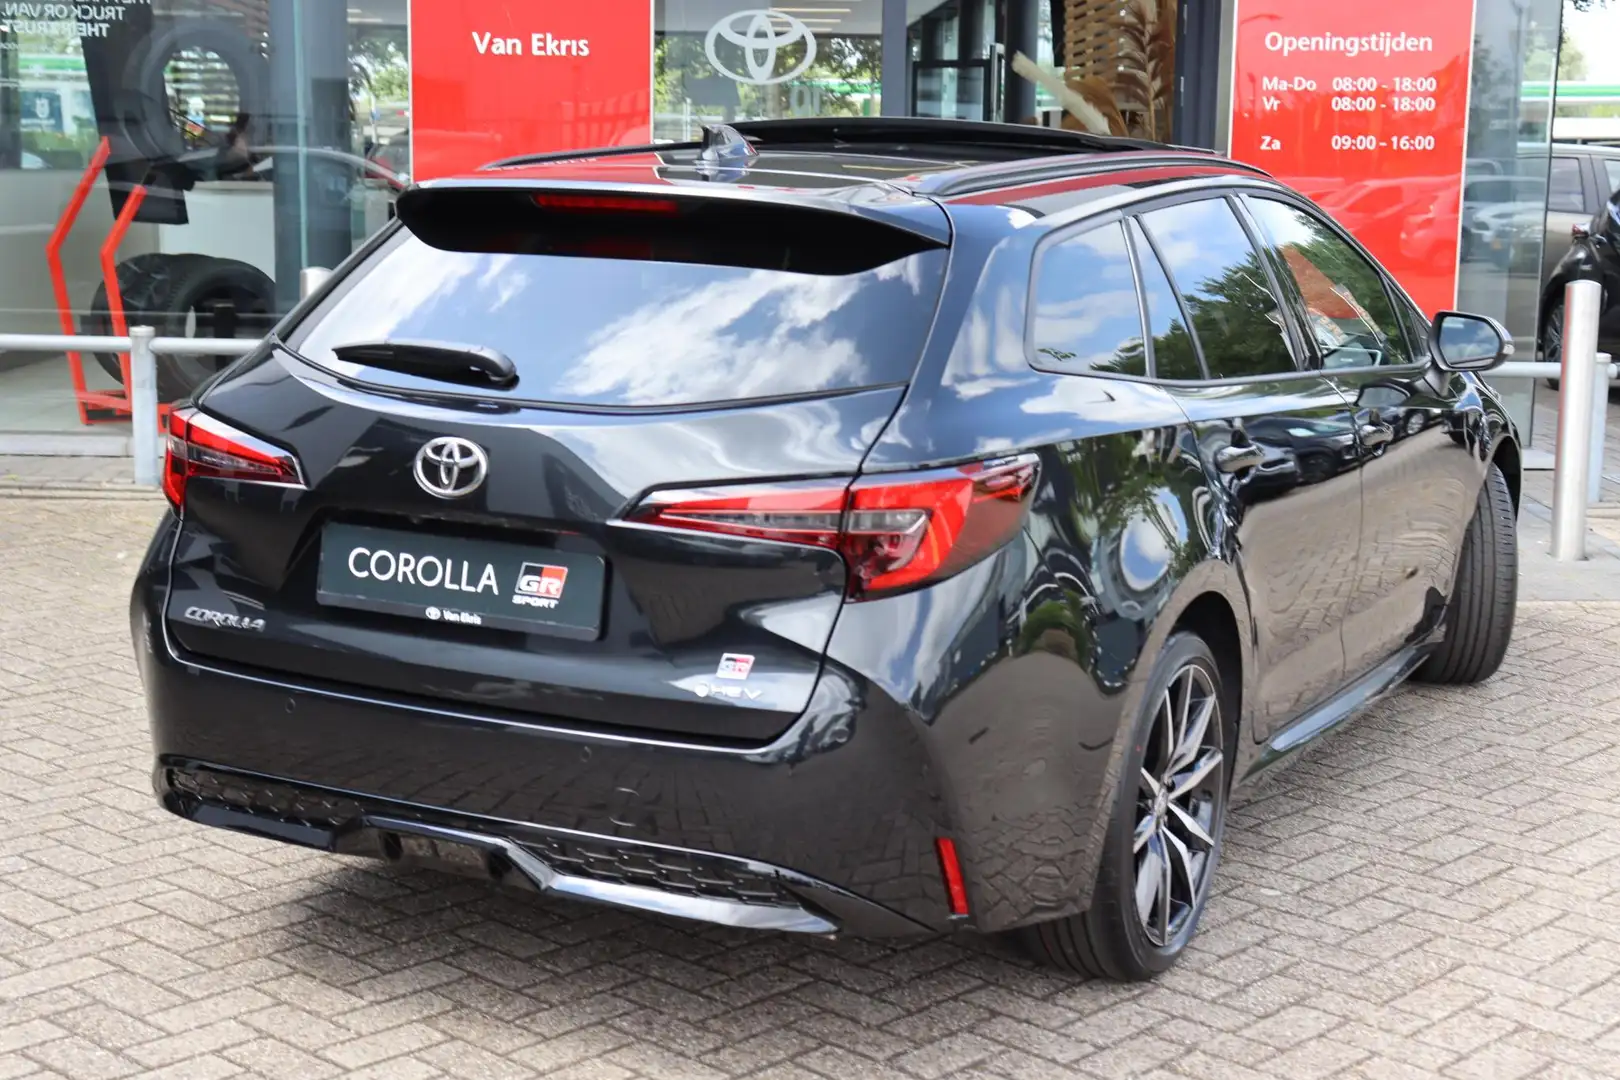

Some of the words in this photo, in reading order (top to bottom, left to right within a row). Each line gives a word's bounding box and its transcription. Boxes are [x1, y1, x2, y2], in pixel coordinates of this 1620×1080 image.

[472, 31, 522, 55] Van
[531, 32, 590, 56] Ekris
[1264, 31, 1433, 57] Openingstijden
[1262, 76, 1317, 91] Ma-Do
[1332, 77, 1377, 92] 08:00
[1393, 77, 1437, 92] 18:00
[1262, 96, 1280, 111] Vr
[1331, 97, 1376, 112] 08:00
[1392, 97, 1436, 112] 18:00
[1260, 136, 1281, 150] Za
[1331, 135, 1376, 150] 09:00
[1391, 135, 1435, 150] 16:00
[348, 547, 499, 595] COROLLA
[519, 574, 561, 595] GR
[512, 594, 559, 609] SPORT
